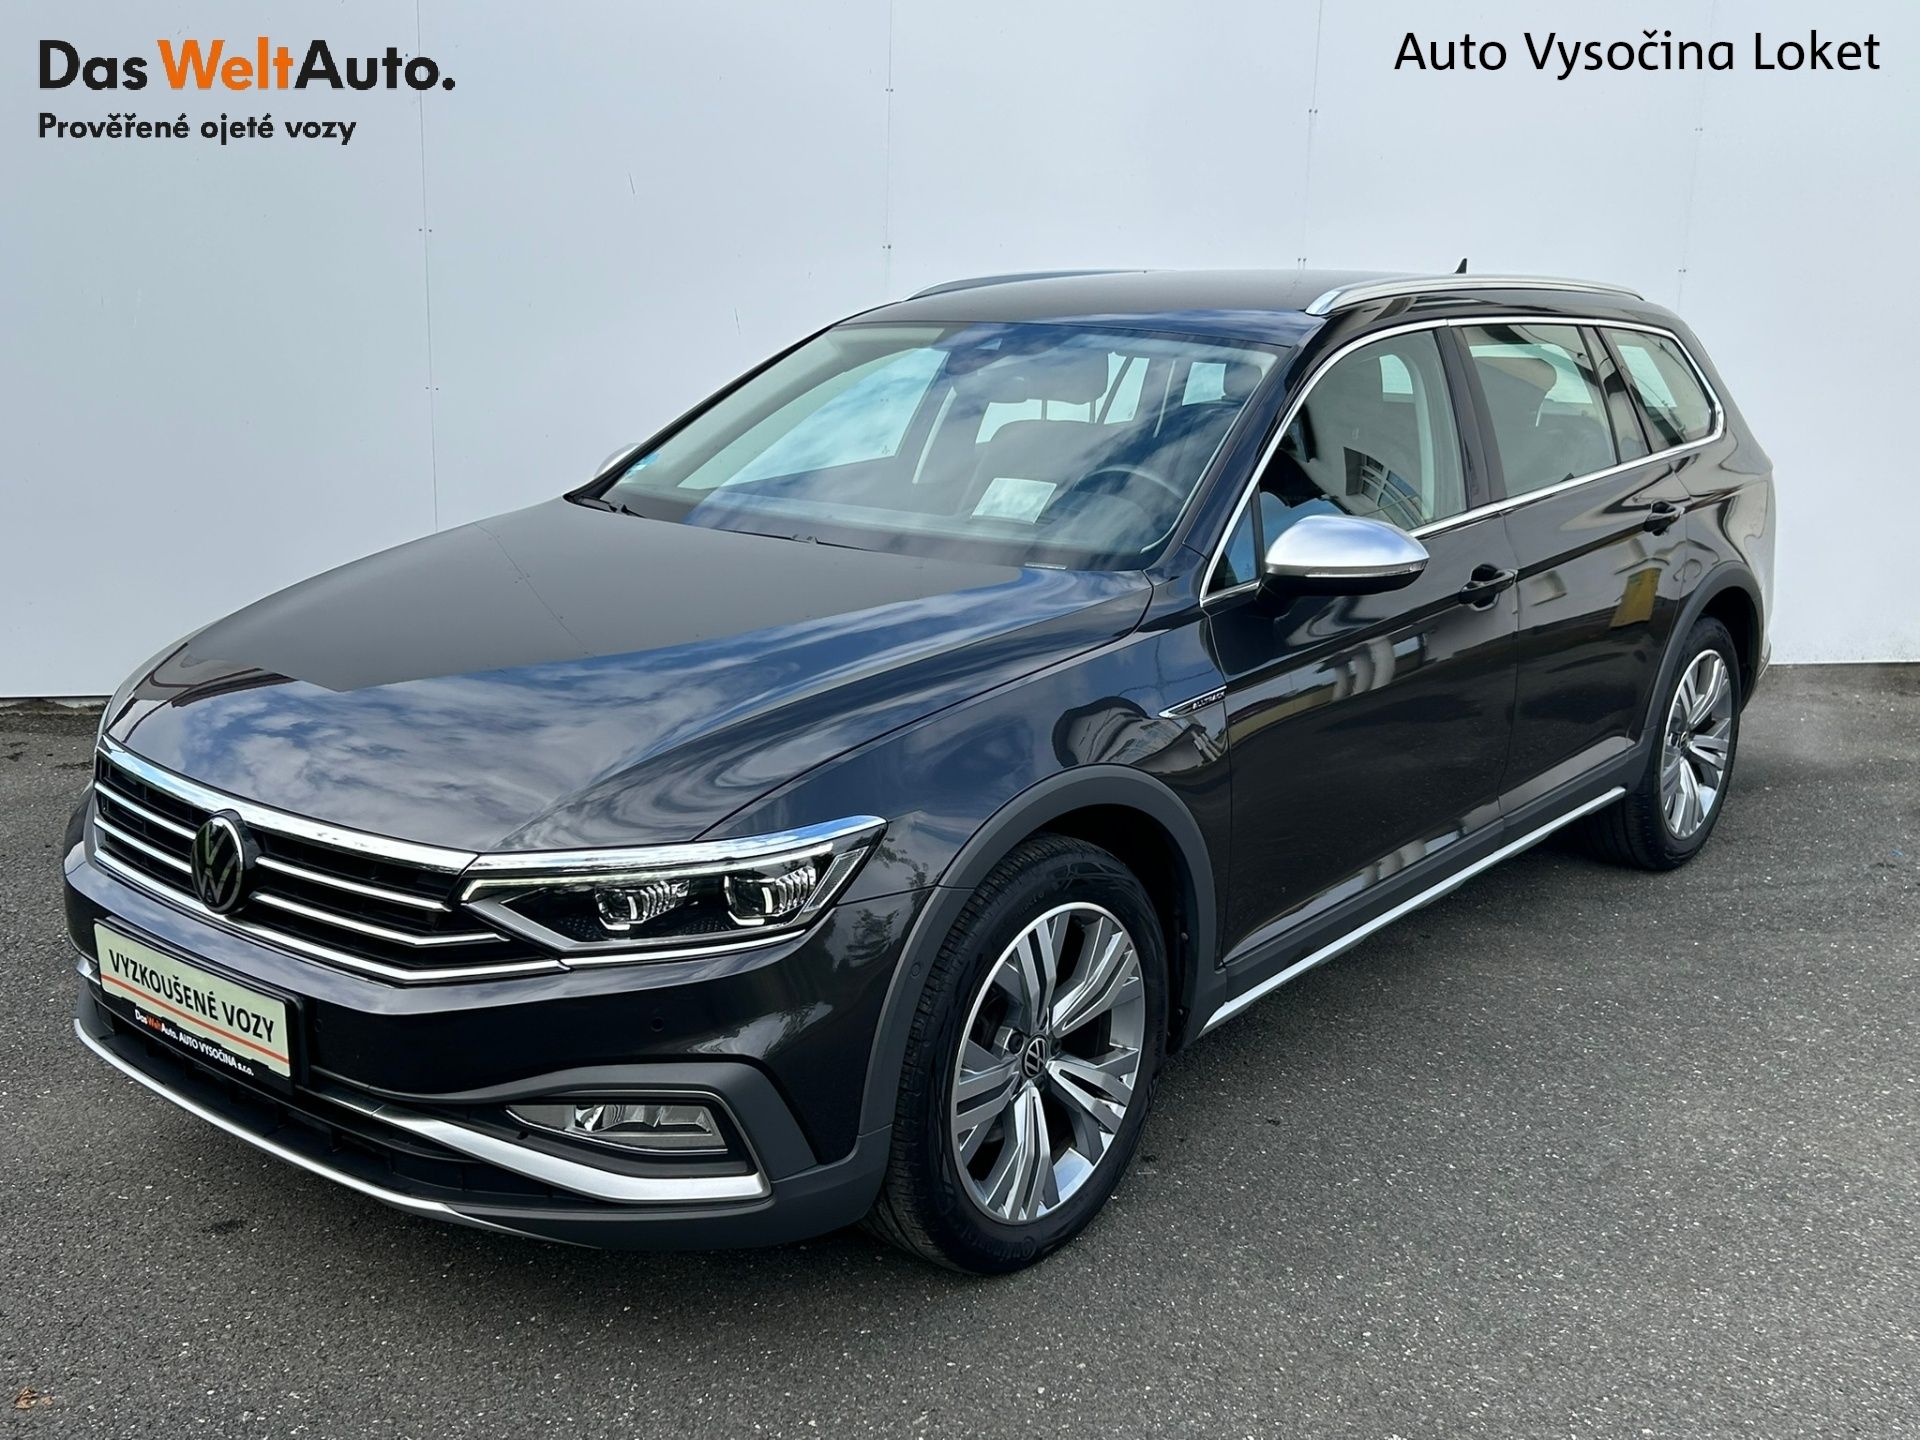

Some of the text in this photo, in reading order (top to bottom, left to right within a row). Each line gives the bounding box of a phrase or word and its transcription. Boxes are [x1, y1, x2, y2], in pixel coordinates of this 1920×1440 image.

[109, 949, 274, 1043] VYZKOUŠENÉ VOZY
[179, 1032, 199, 1050] AUTO
[199, 1042, 238, 1069] VYSOČINA
